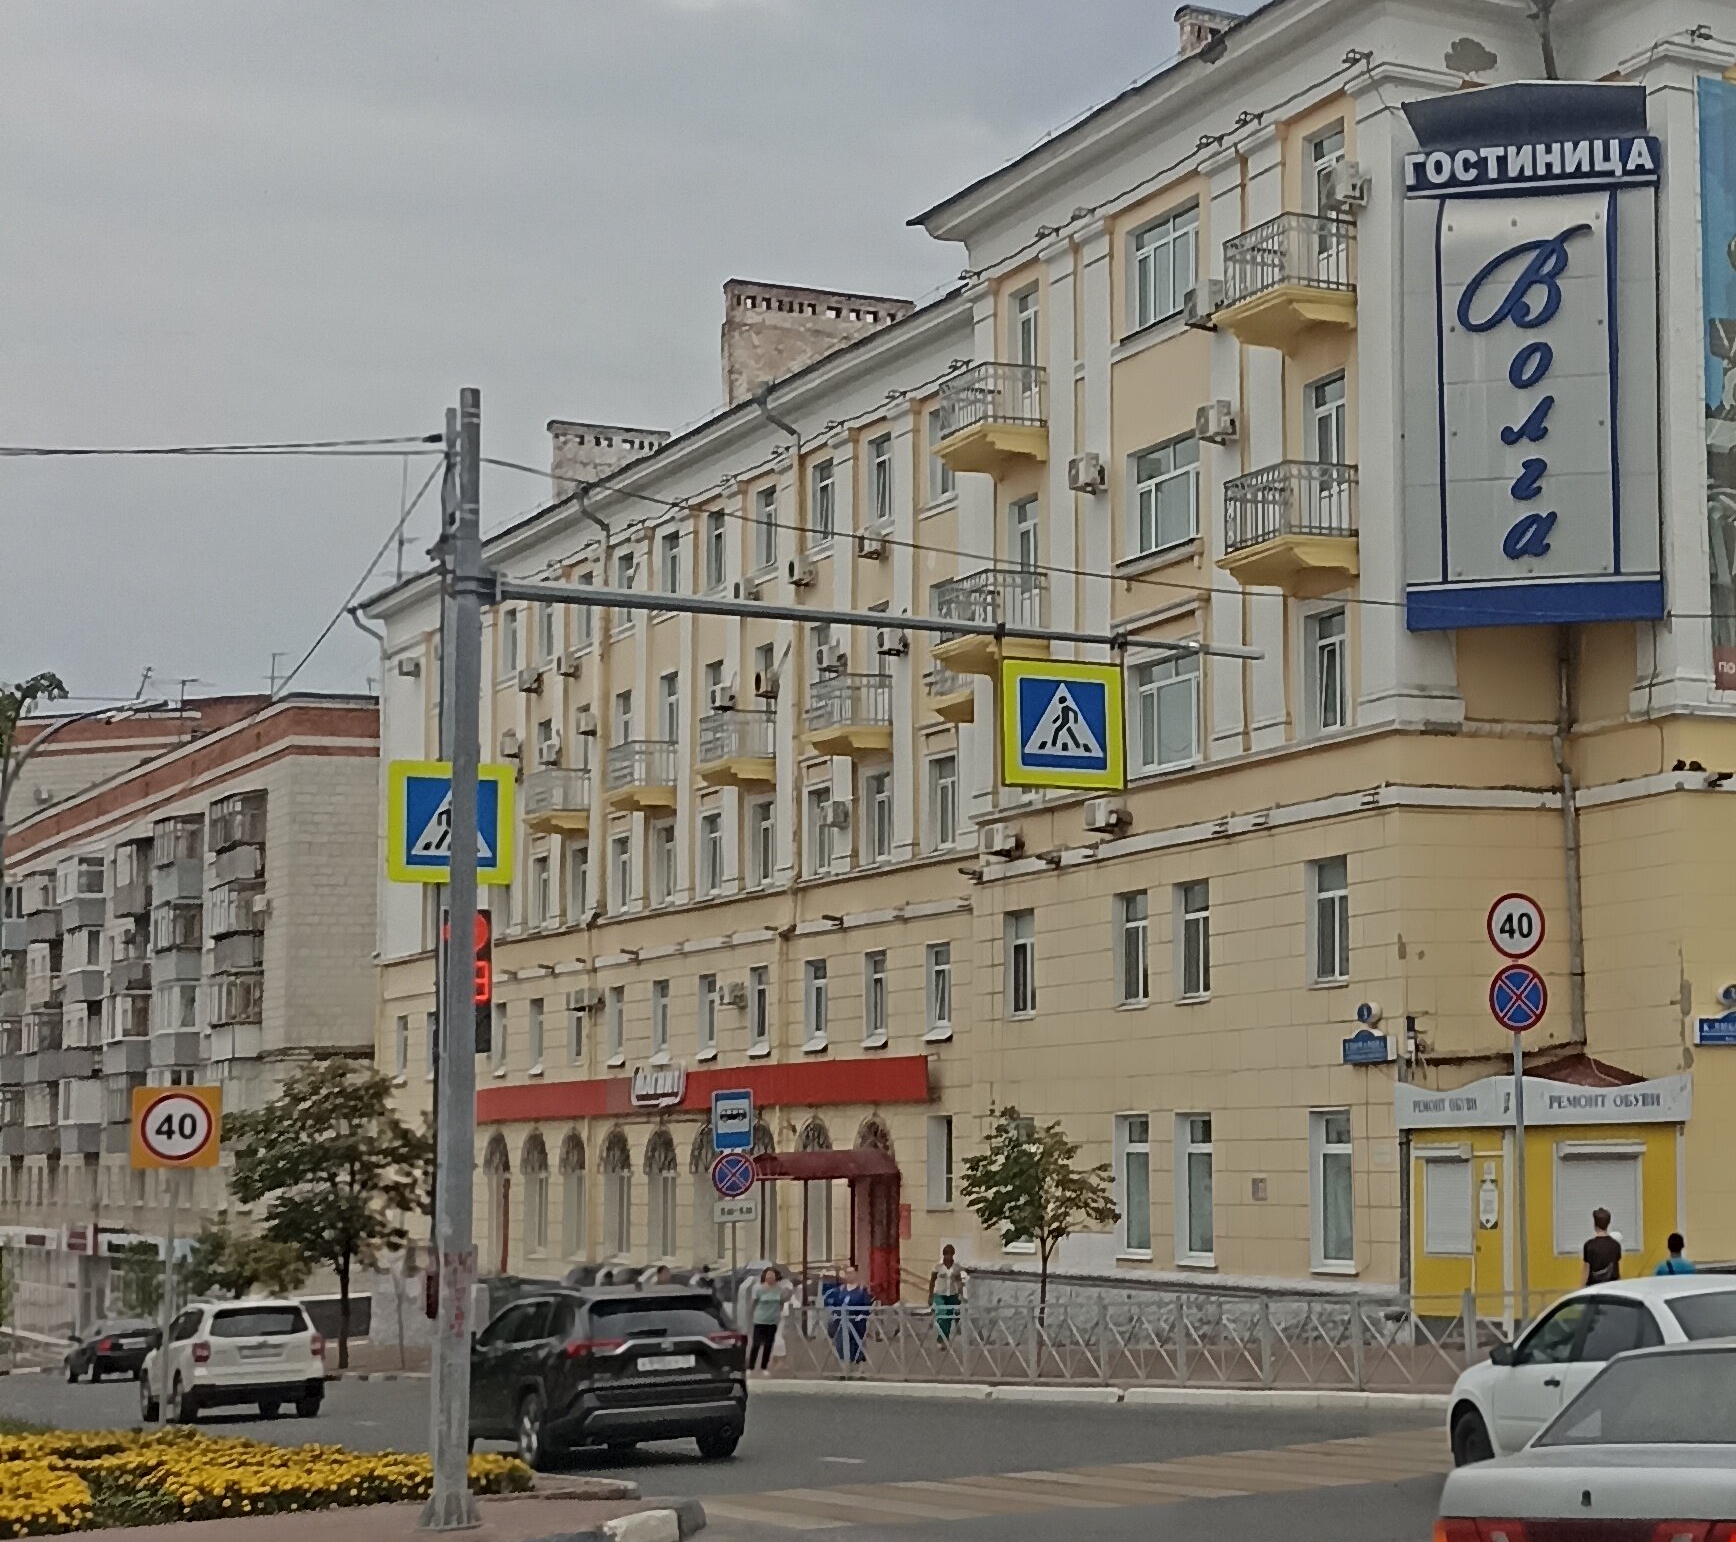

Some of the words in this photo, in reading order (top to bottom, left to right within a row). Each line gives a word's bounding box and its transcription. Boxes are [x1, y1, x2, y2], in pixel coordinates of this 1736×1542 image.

[1404, 138, 1654, 186] ГОСТИНИЦА
[1456, 222, 1593, 561] Волга
[1718, 661, 1736, 675] ПО
[1499, 912, 1532, 939] 40
[1412, 1097, 1446, 1113] РЕМОНТ
[1449, 1096, 1477, 1111] ОБУВИ
[1549, 1093, 1606, 1109] РЕМОНТ
[1613, 1092, 1661, 1107] ОБУВИ
[154, 1112, 198, 1141] 40
